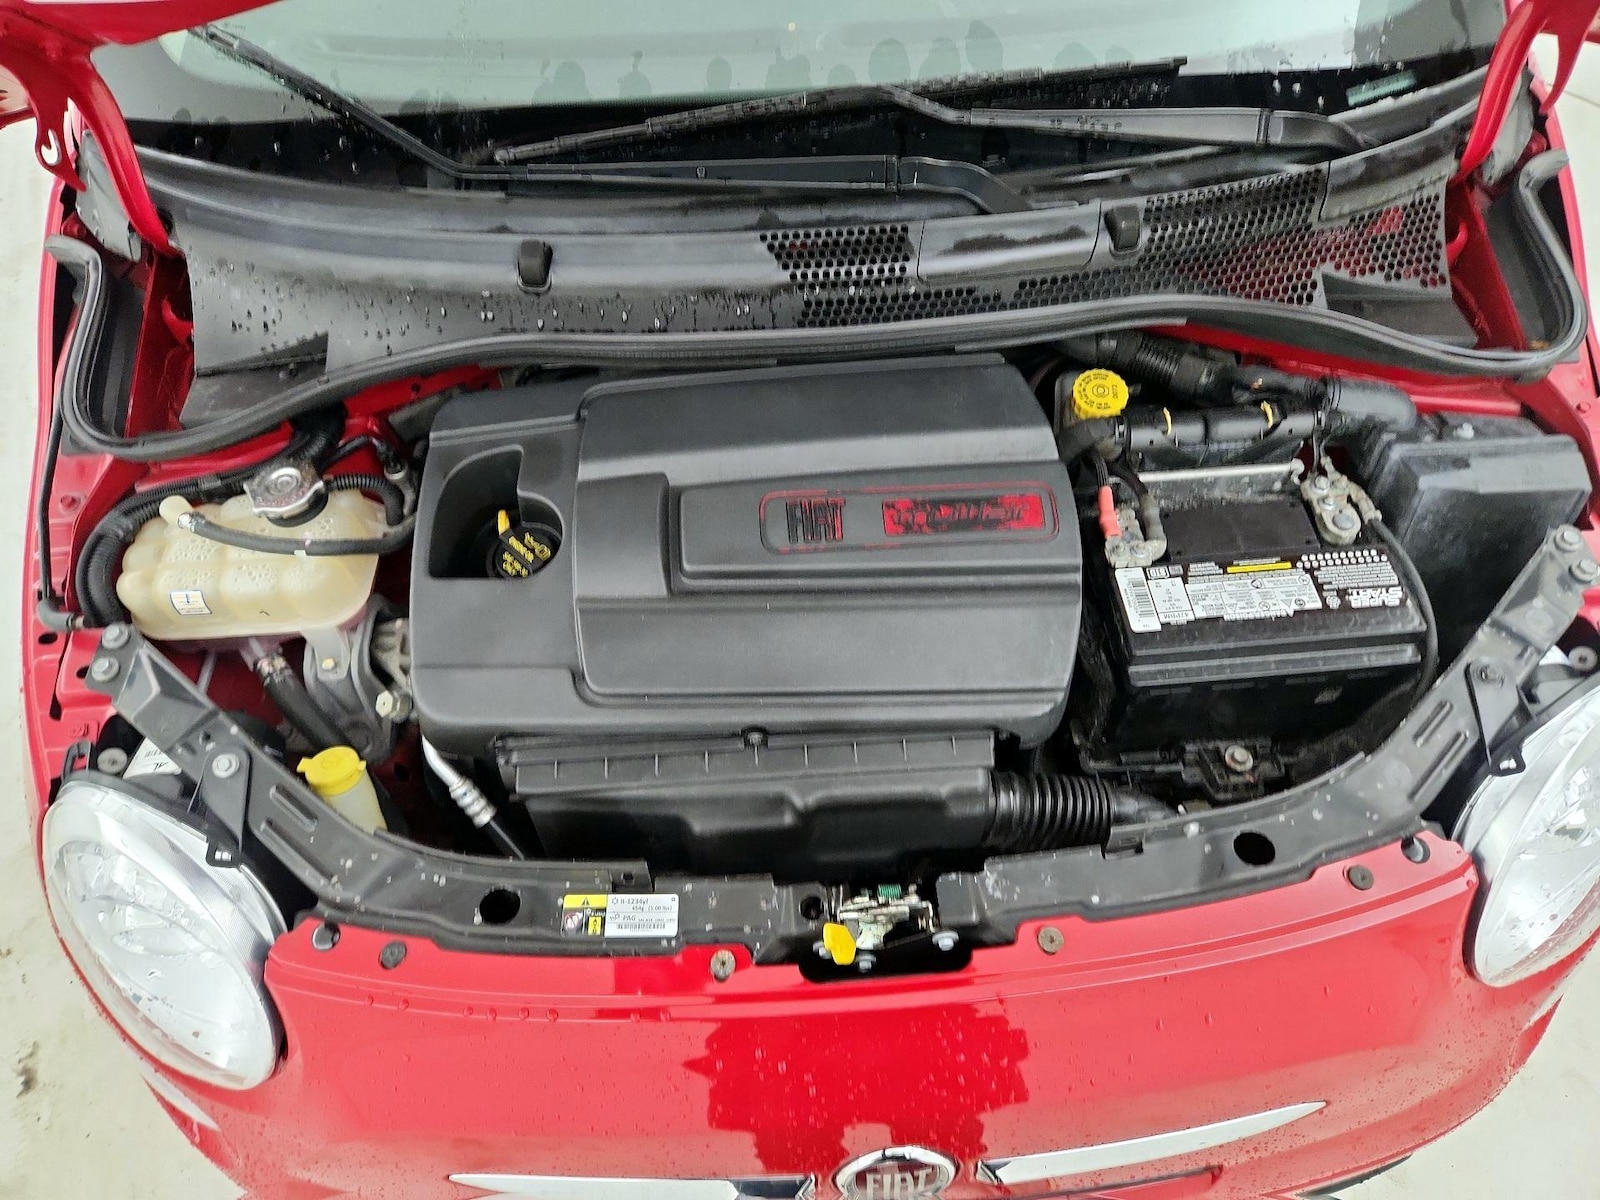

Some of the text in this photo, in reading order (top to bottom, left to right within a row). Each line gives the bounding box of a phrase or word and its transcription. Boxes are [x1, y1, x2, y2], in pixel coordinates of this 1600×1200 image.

[786, 498, 846, 544] FIAT
[1348, 586, 1403, 600] START
[1350, 597, 1401, 609] SUPER
[866, 1168, 933, 1200] FIAT
